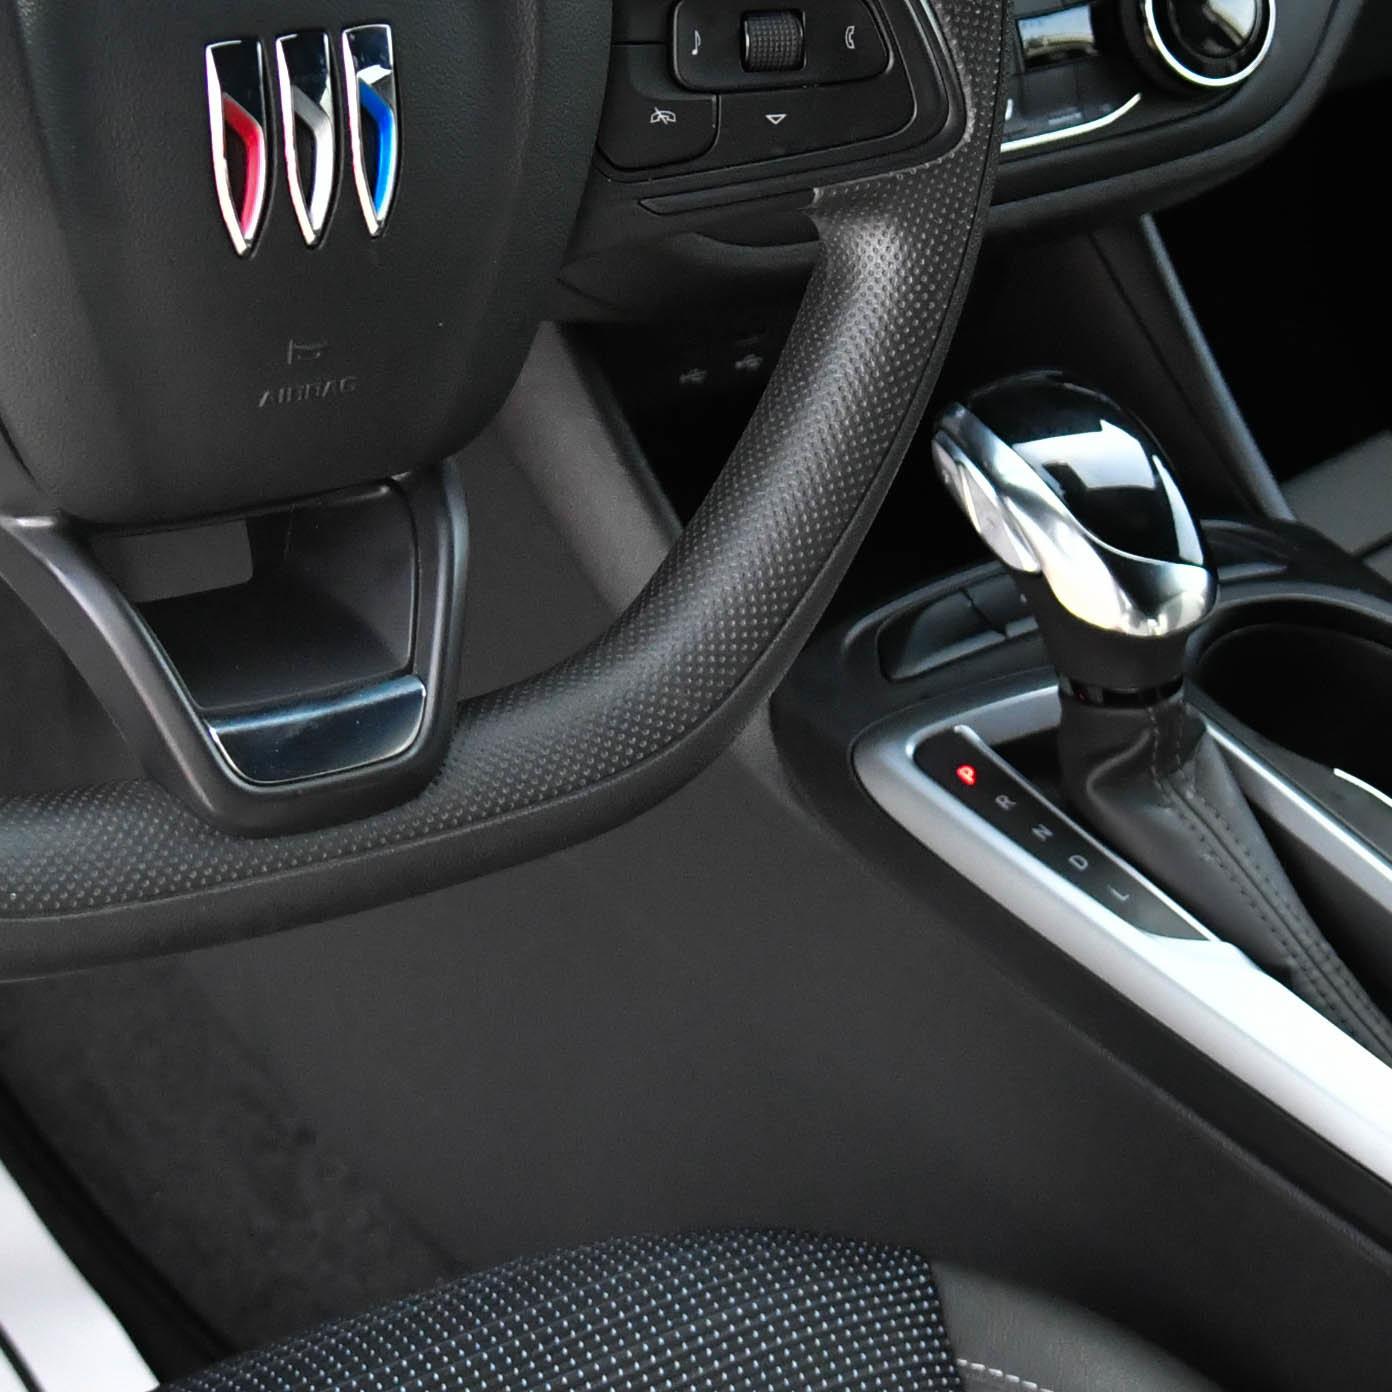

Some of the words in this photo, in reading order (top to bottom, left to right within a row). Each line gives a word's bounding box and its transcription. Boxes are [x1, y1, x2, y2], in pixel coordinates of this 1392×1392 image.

[956, 764, 976, 786] P
[995, 794, 1017, 810] R
[1032, 823, 1053, 841] N
[1068, 854, 1089, 871] D
[1108, 884, 1130, 901] L
